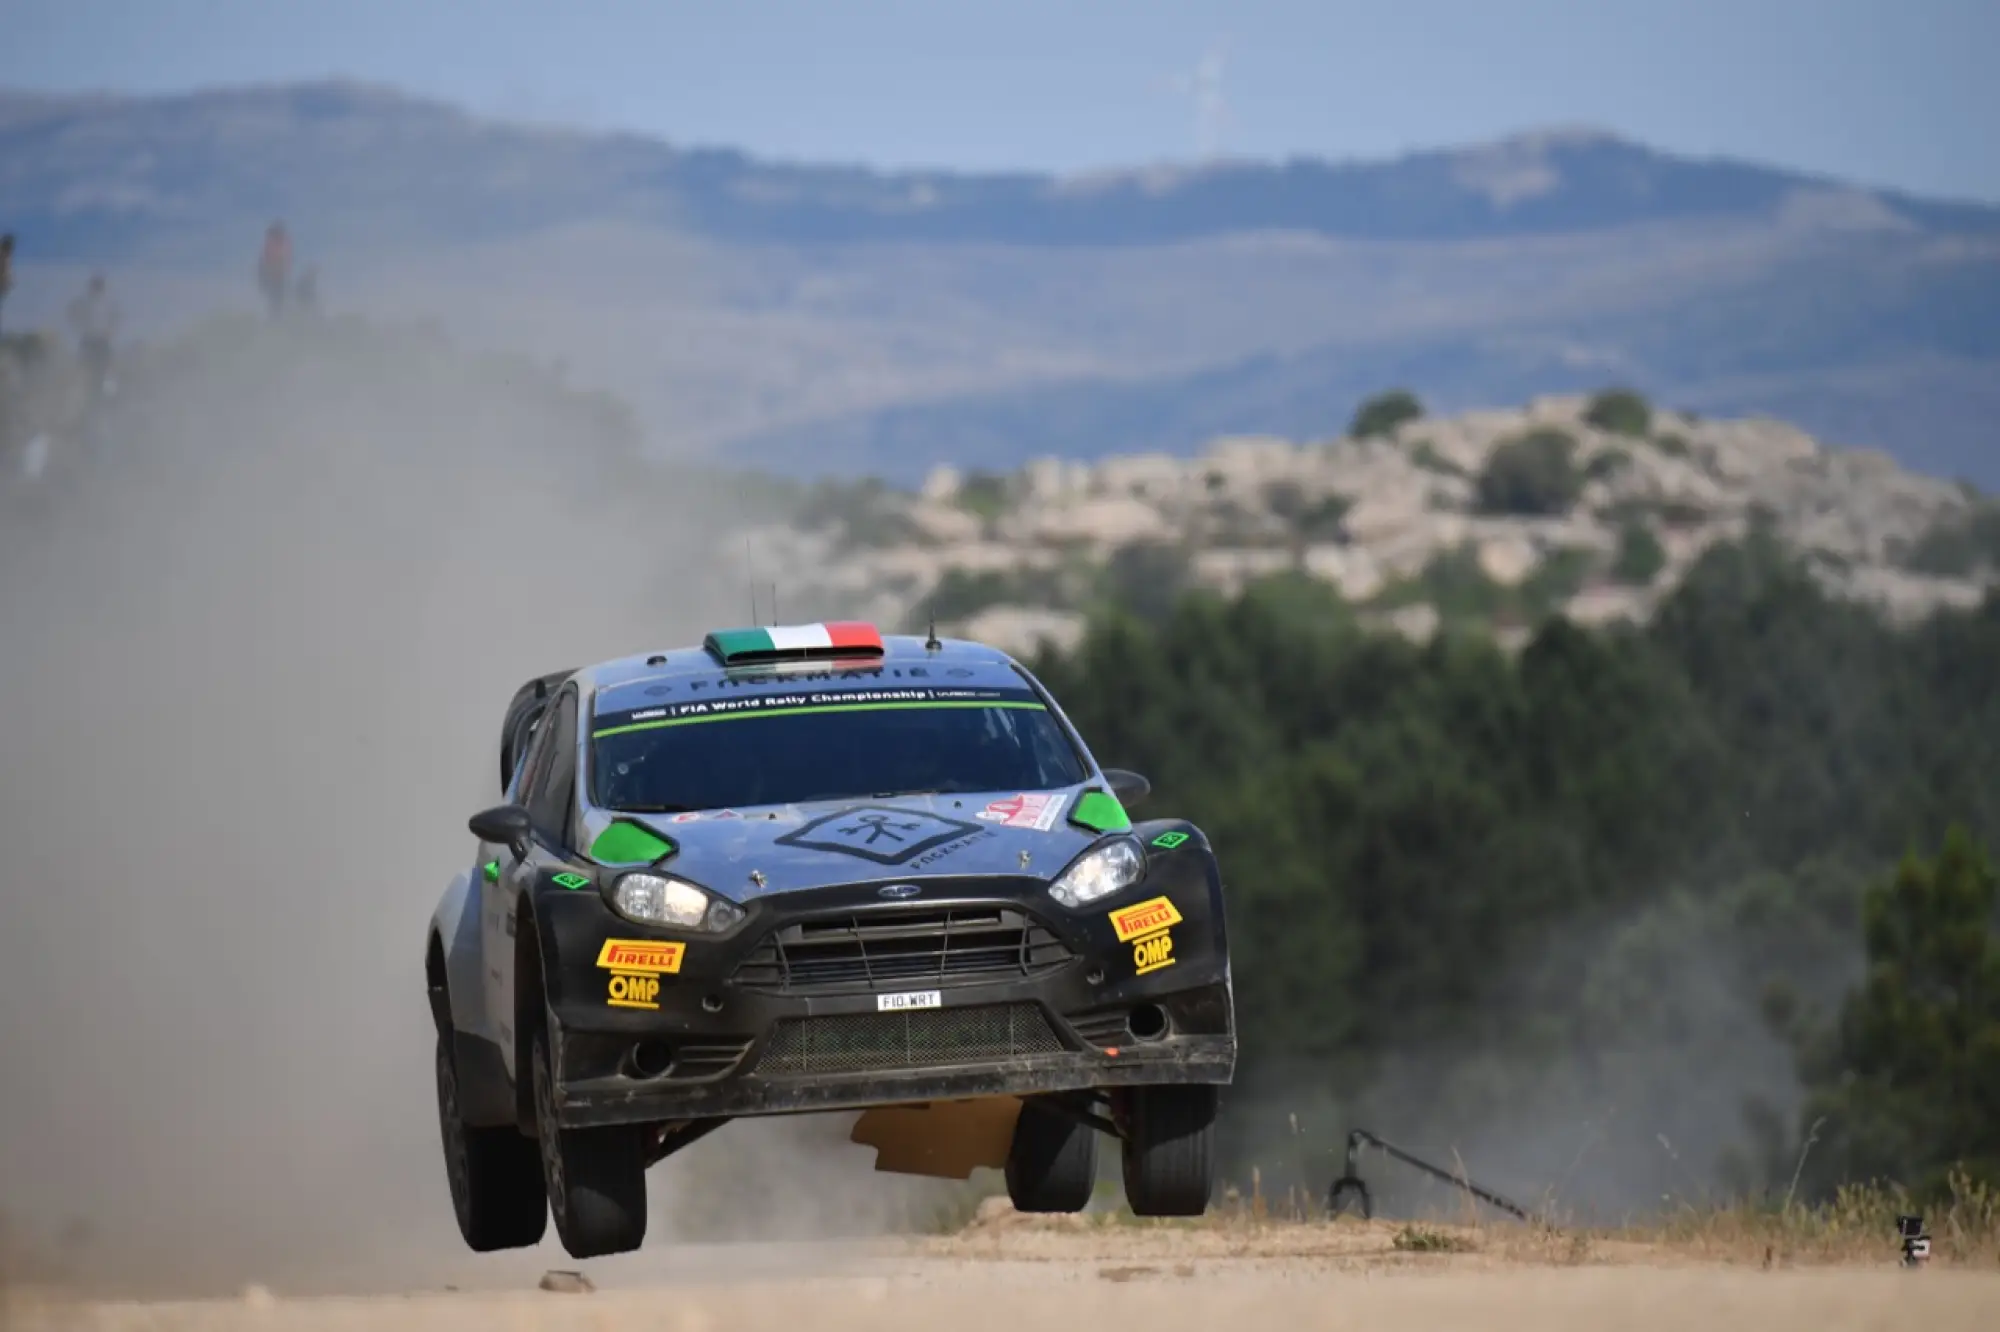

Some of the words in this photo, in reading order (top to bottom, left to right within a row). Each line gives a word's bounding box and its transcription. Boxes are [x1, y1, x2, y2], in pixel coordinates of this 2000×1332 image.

[680, 705, 708, 713] FIA
[711, 699, 760, 710] World
[765, 694, 806, 705] Rally
[811, 690, 926, 704] Championship
[1117, 903, 1171, 934] PIRELLI
[607, 944, 676, 966] PIRELLI
[1133, 935, 1173, 968] OMP
[608, 976, 660, 1002] OMP
